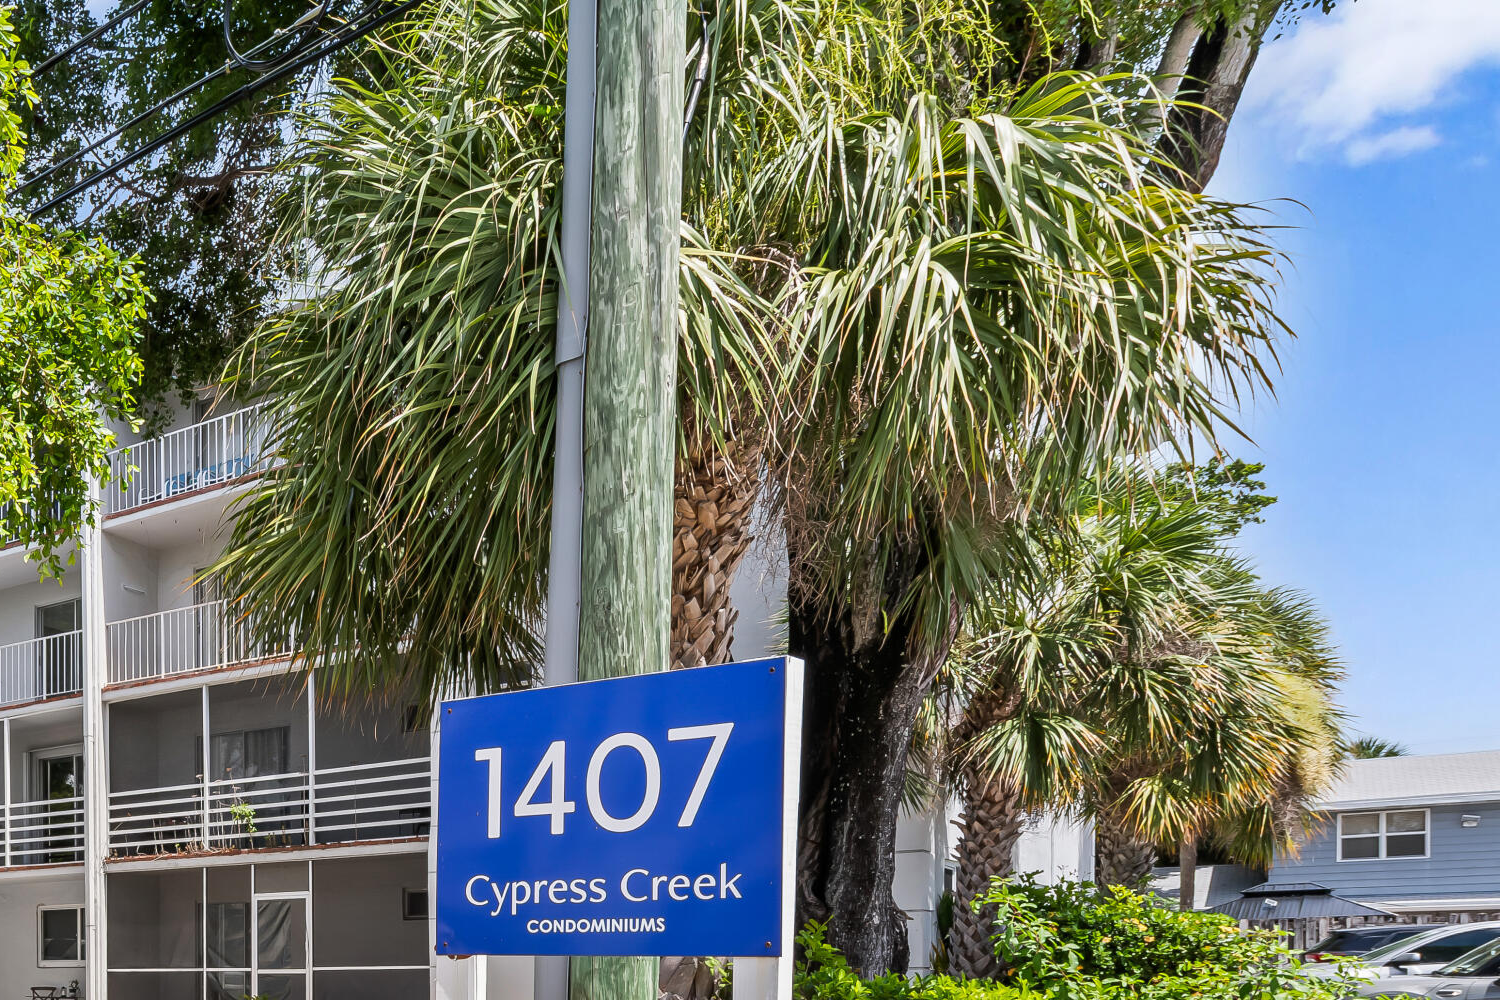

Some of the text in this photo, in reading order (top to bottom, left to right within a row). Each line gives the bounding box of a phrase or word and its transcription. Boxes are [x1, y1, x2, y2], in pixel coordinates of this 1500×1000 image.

[474, 722, 735, 839] 1407
[464, 862, 743, 917] Cypress Creek
[526, 917, 666, 934] CONDOMINIUMS
